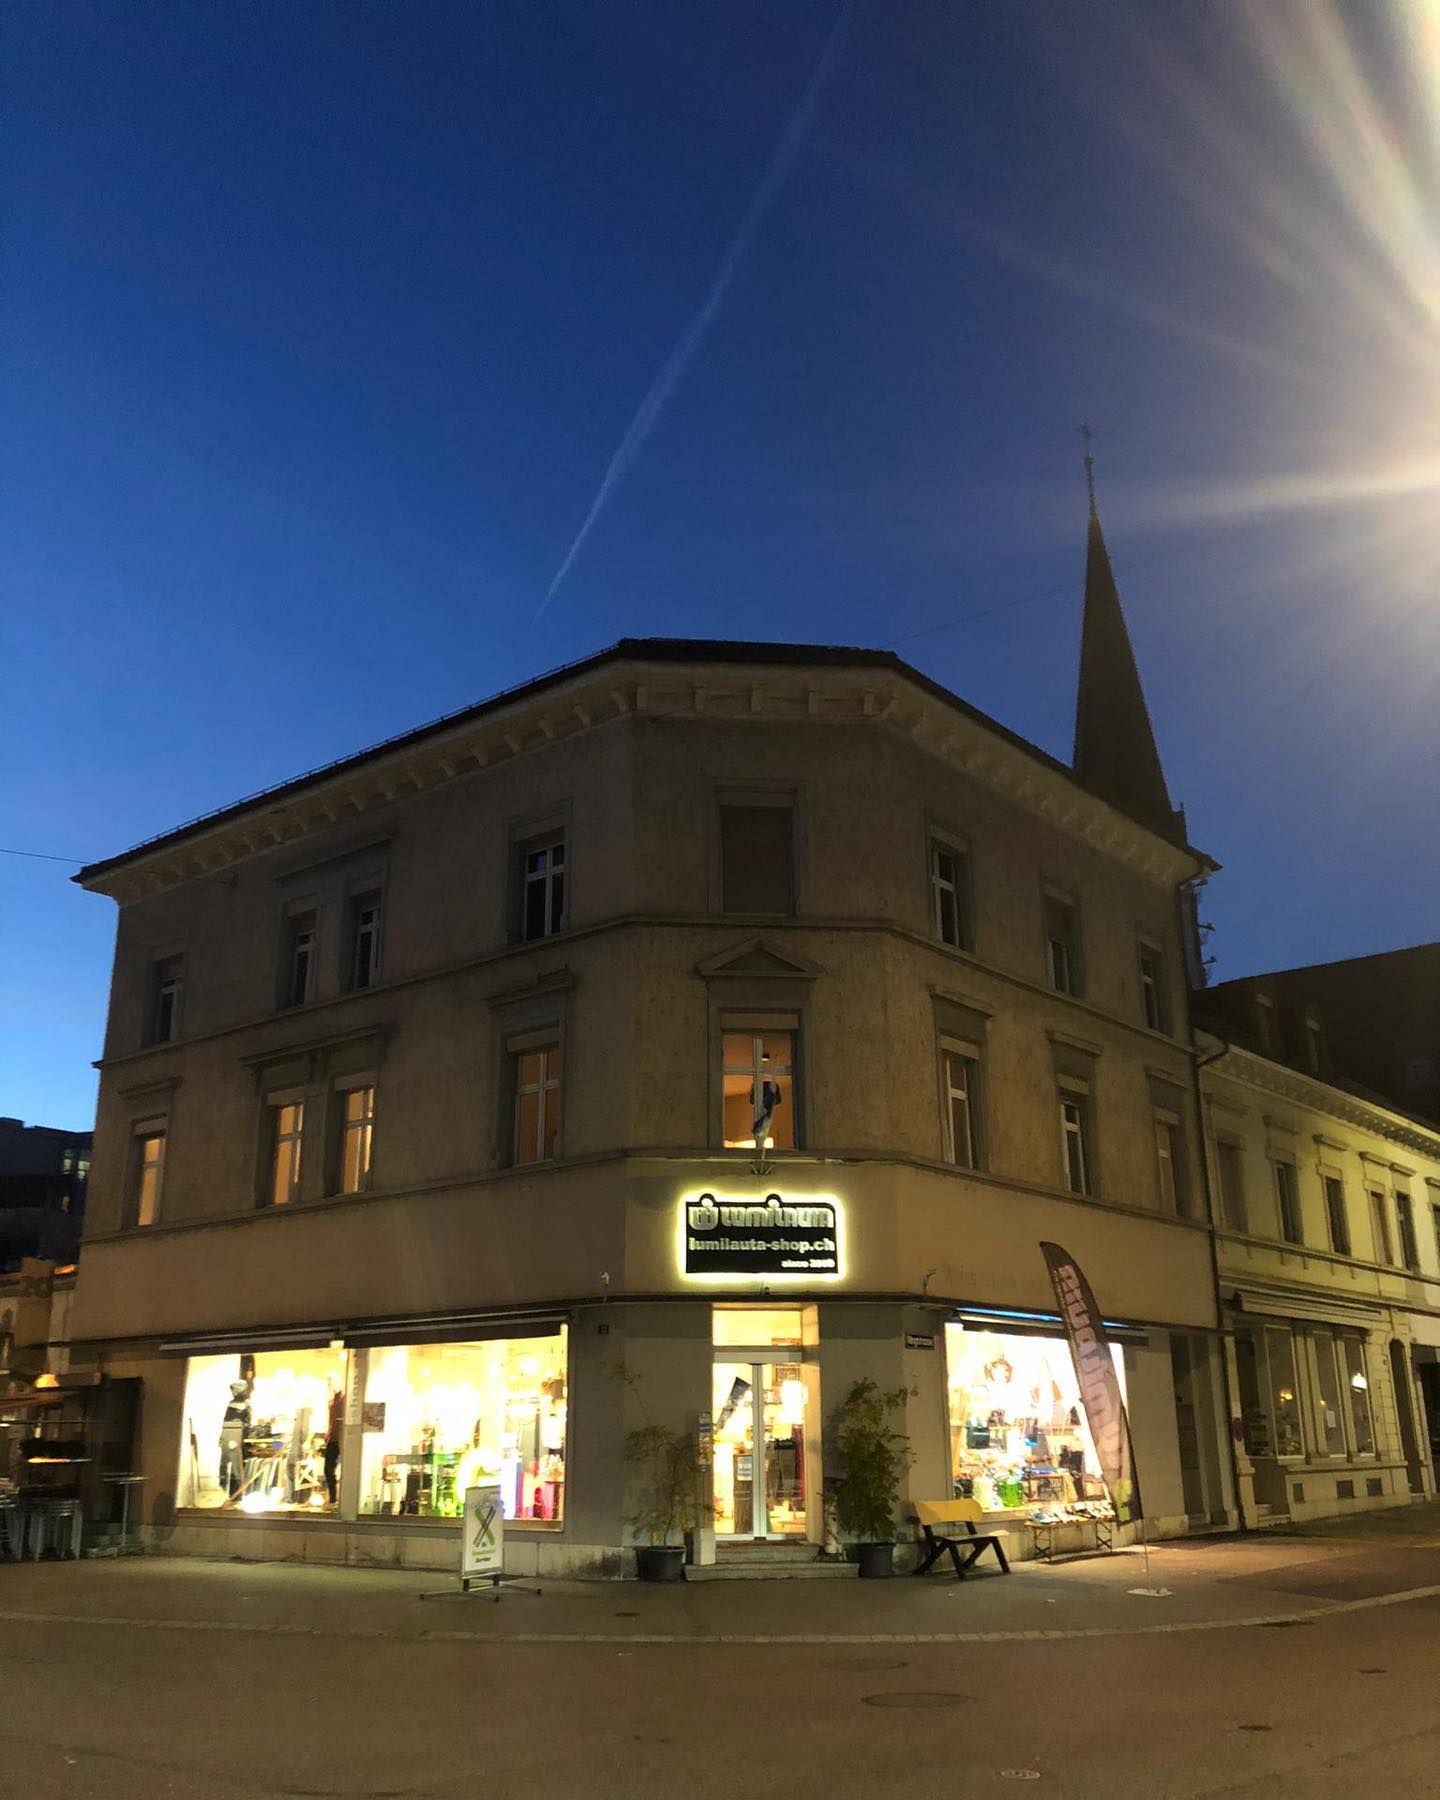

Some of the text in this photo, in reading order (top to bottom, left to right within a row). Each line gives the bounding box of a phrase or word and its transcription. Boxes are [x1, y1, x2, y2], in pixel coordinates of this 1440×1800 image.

[720, 1200, 835, 1228] lumilauta
[688, 1237, 835, 1254] lumilauta-shop.ch
[781, 1258, 809, 1268] since
